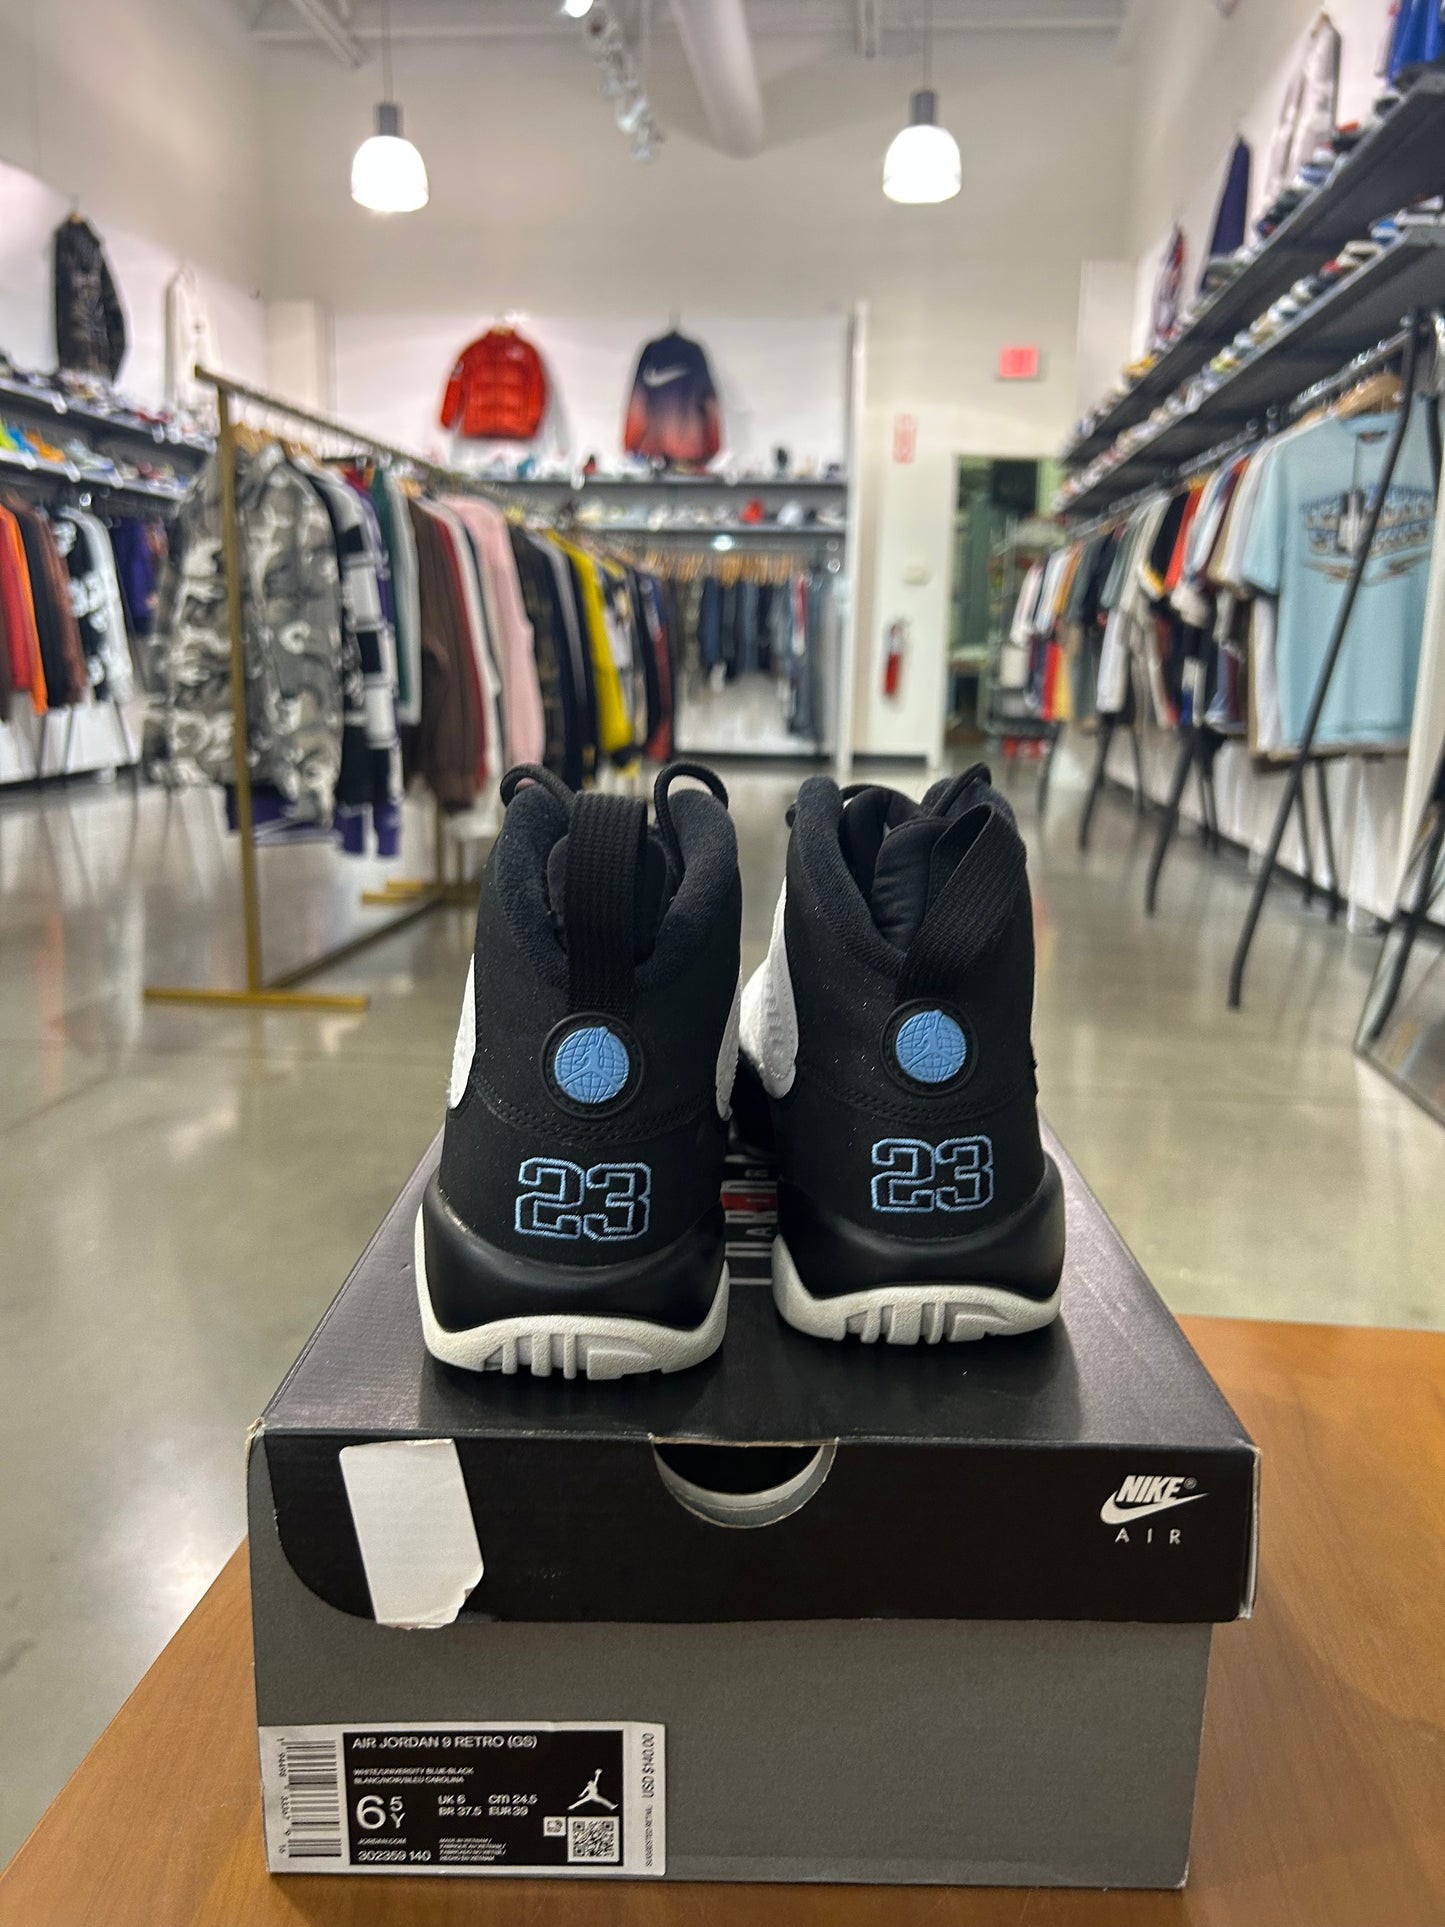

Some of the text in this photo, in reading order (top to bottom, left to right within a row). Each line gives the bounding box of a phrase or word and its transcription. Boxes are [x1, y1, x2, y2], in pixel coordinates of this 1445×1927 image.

[870, 1134, 995, 1214] 23
[514, 1156, 653, 1242] 23
[1114, 1527, 1182, 1545] AIR
[352, 1736, 378, 1749] AIR
[380, 1735, 440, 1749] JORDAN
[442, 1735, 452, 1748] 9
[454, 1735, 505, 1748] RETRO
[641, 1732, 655, 1799] USD $140.00
[389, 1796, 404, 1811] 5
[437, 1794, 455, 1805] UK
[511, 1793, 538, 1805] 24.5
[356, 1794, 387, 1830] 6
[438, 1805, 482, 1817] BR 37.5
[488, 1805, 512, 1816] EUR
[390, 1812, 406, 1829] Y
[408, 1849, 432, 1861] 140
